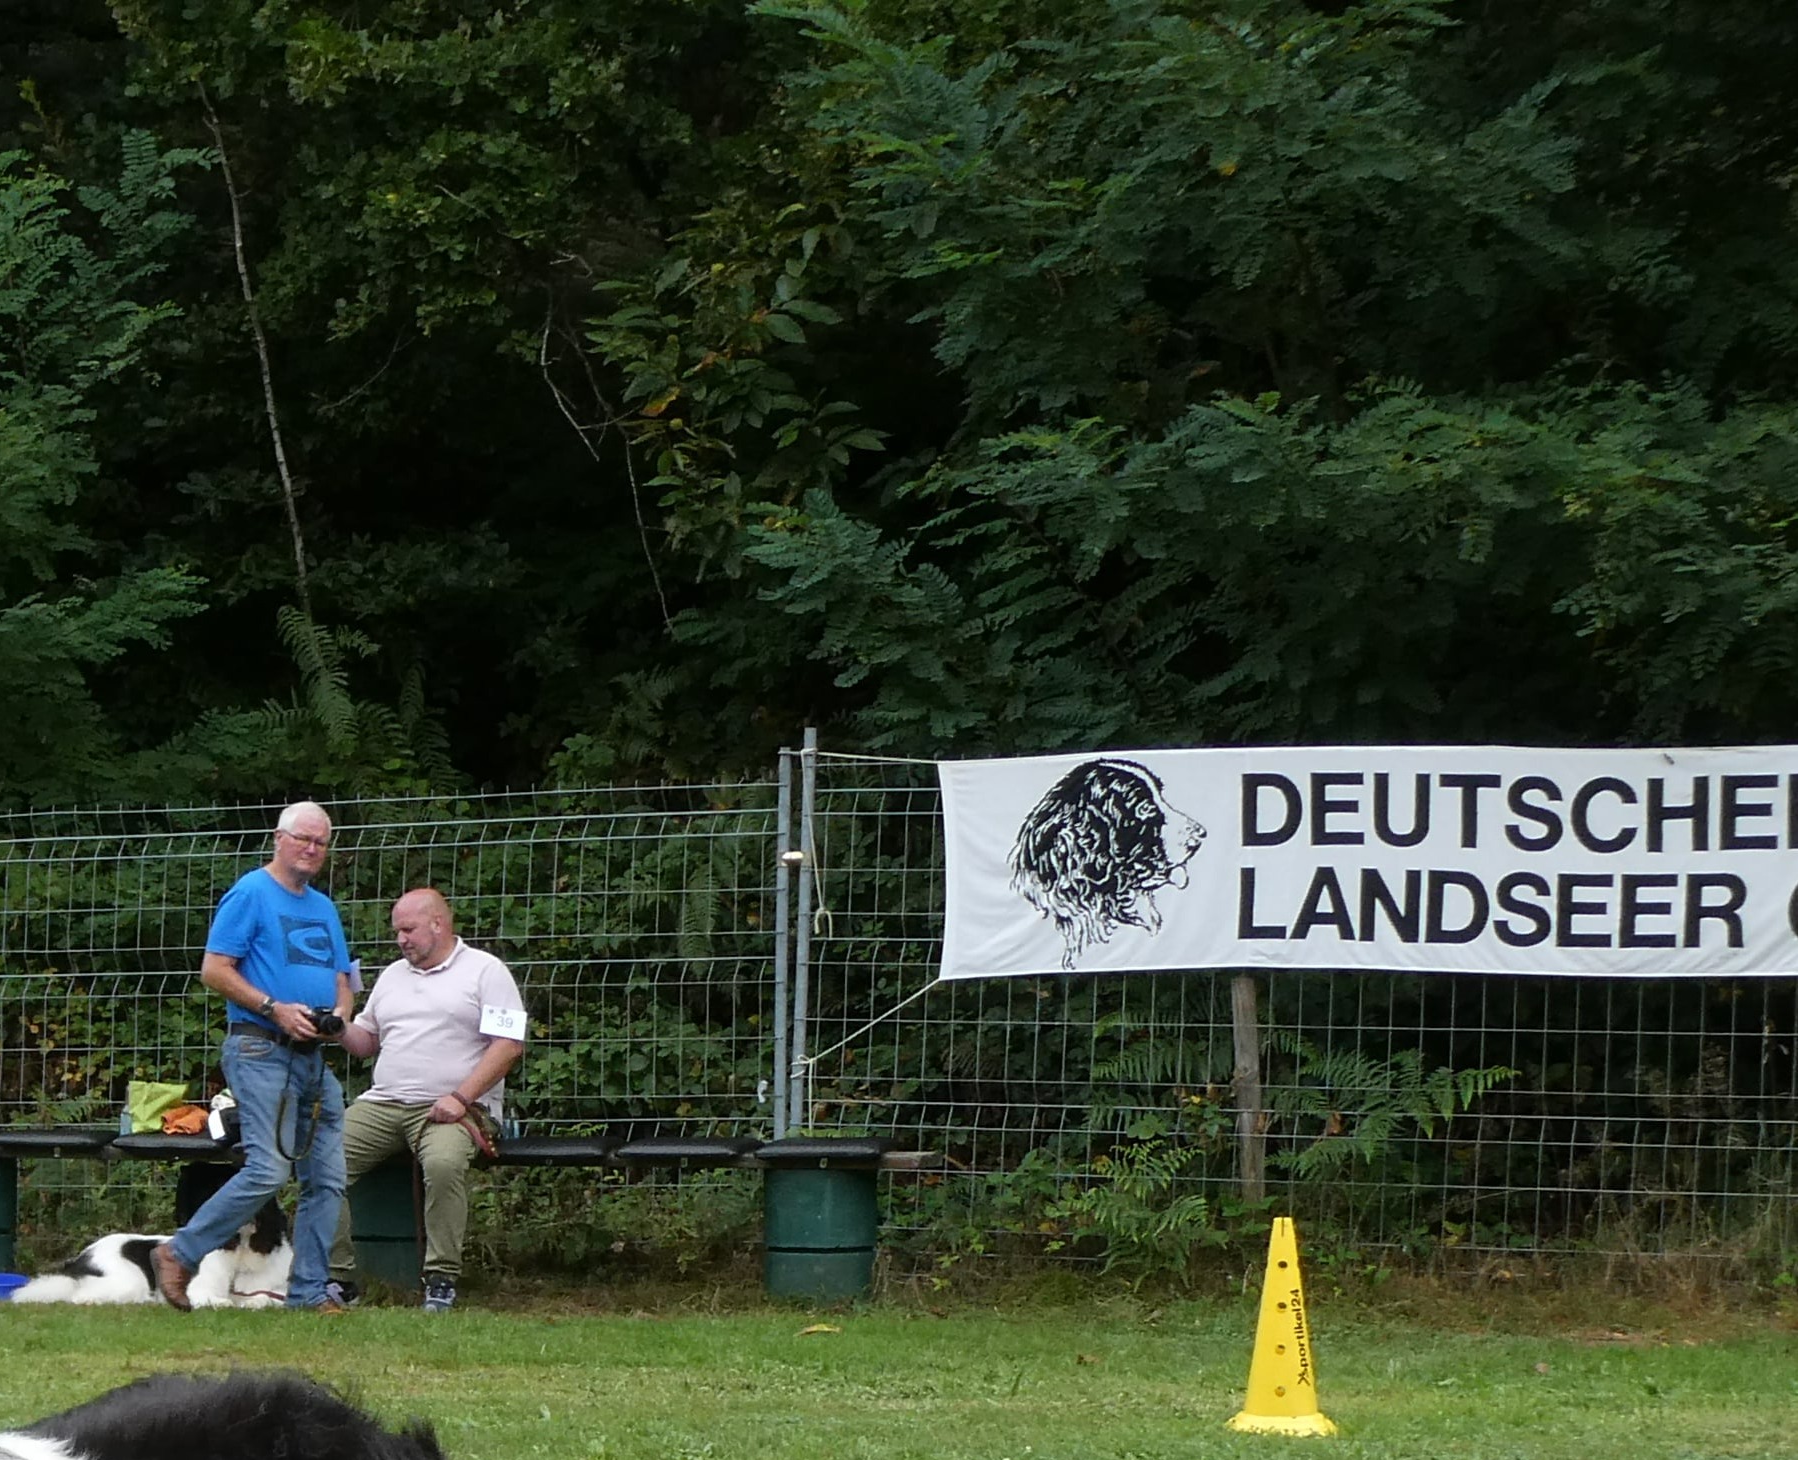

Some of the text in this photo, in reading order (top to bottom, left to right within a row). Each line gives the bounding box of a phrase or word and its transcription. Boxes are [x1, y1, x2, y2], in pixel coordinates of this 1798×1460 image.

[1240, 772, 1798, 853] DEUTSCHE
[1237, 866, 1748, 949] LANDSEER
[496, 1015, 514, 1029] 39
